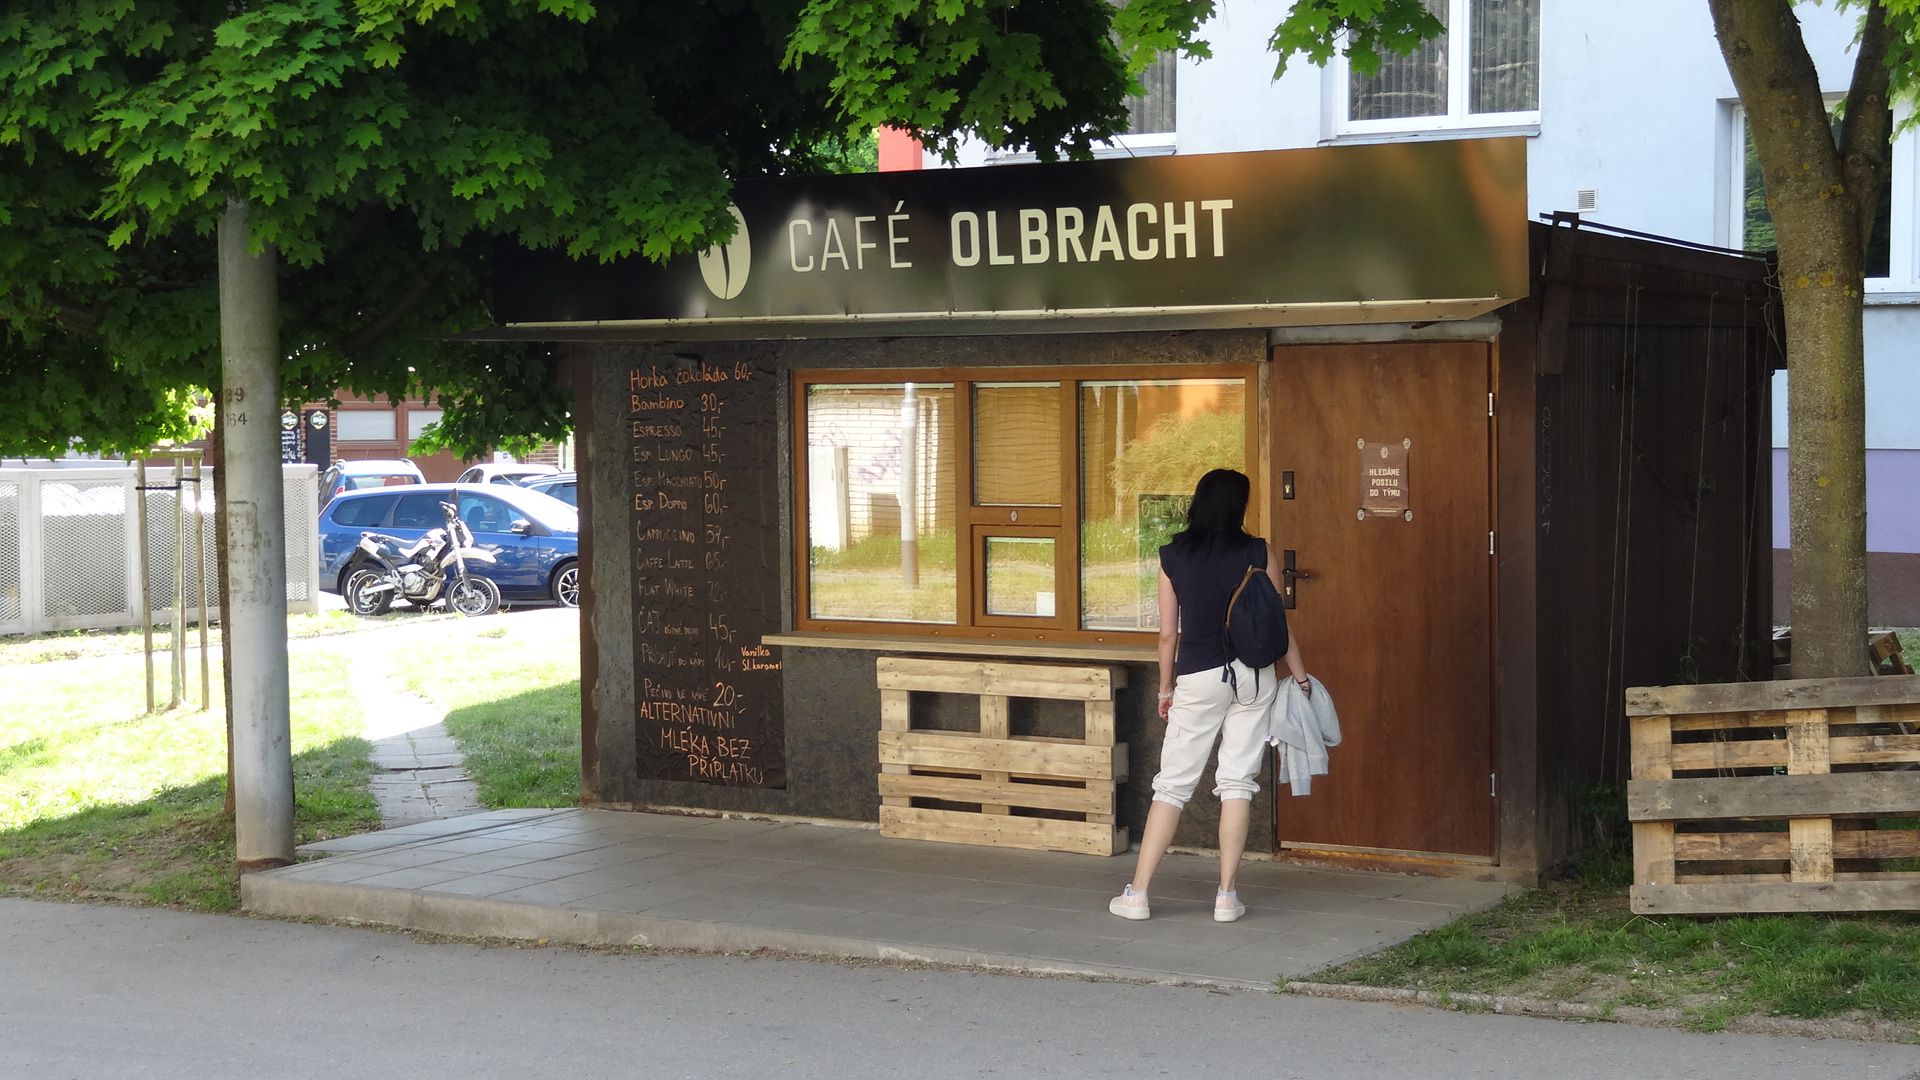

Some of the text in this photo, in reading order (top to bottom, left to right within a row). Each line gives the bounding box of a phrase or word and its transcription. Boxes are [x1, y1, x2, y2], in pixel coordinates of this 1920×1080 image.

[788, 199, 1234, 272] CAFÉ OLBRACHT
[631, 393, 684, 413] Bambino
[1369, 467, 1400, 476] HLEDÁME
[1371, 478, 1398, 487] POSILU
[1369, 487, 1401, 497] DO TÝMU
[740, 645, 770, 657] Vanilka
[660, 725, 751, 759] MLÉKA BEZ
